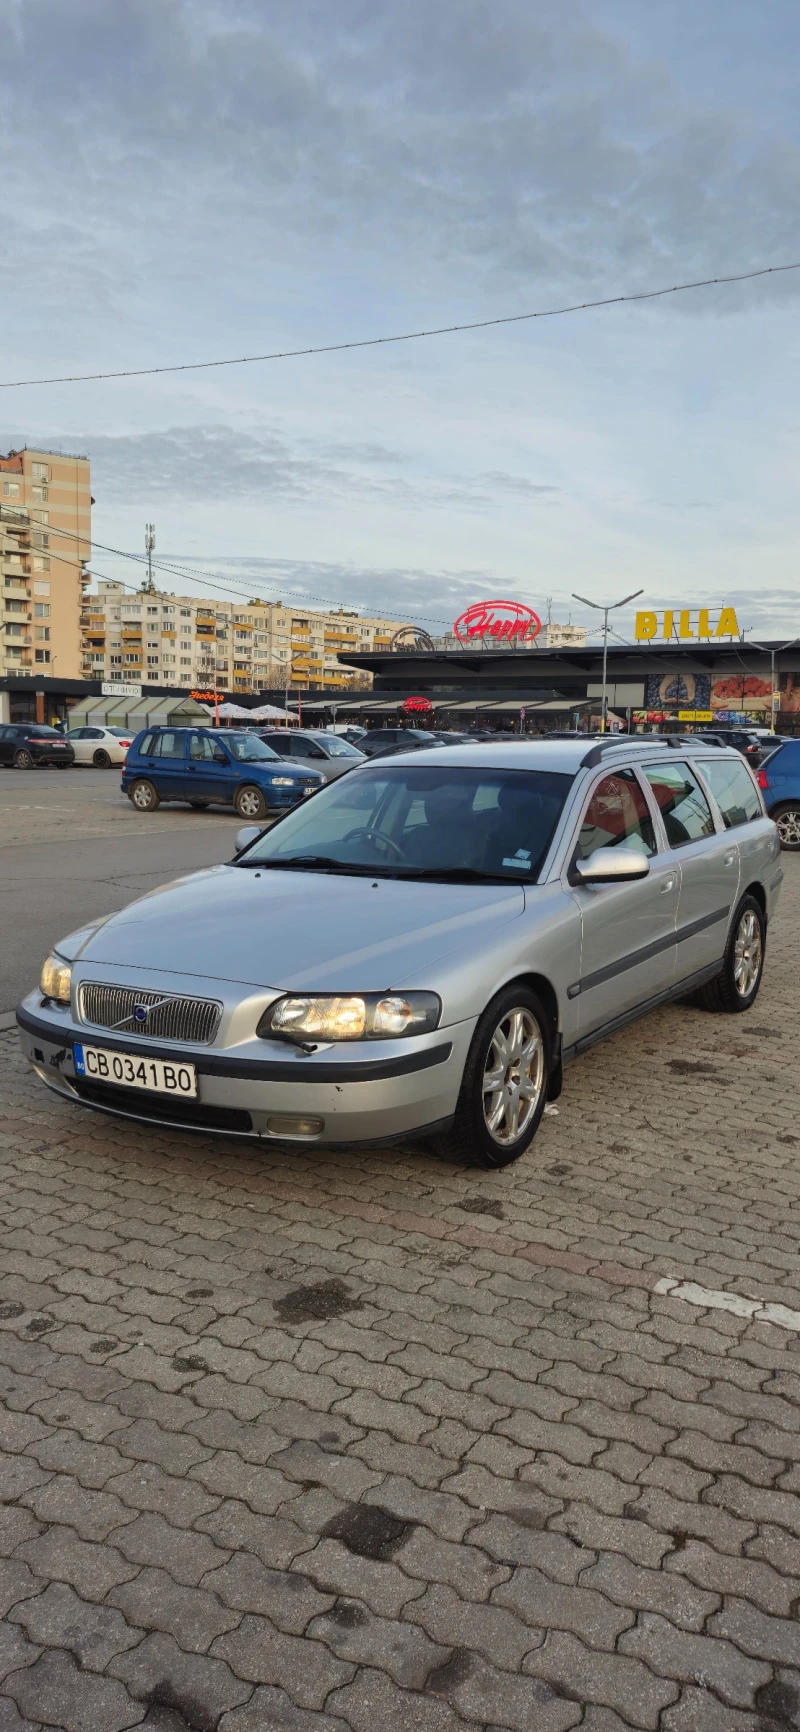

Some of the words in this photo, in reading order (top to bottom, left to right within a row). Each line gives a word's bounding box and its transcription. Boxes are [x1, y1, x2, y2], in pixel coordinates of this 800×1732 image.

[463, 611, 534, 641] Happy
[635, 607, 739, 639] BILLA
[85, 1049, 110, 1077] CB
[112, 1056, 158, 1087] 0341
[163, 1064, 191, 1091] BO
